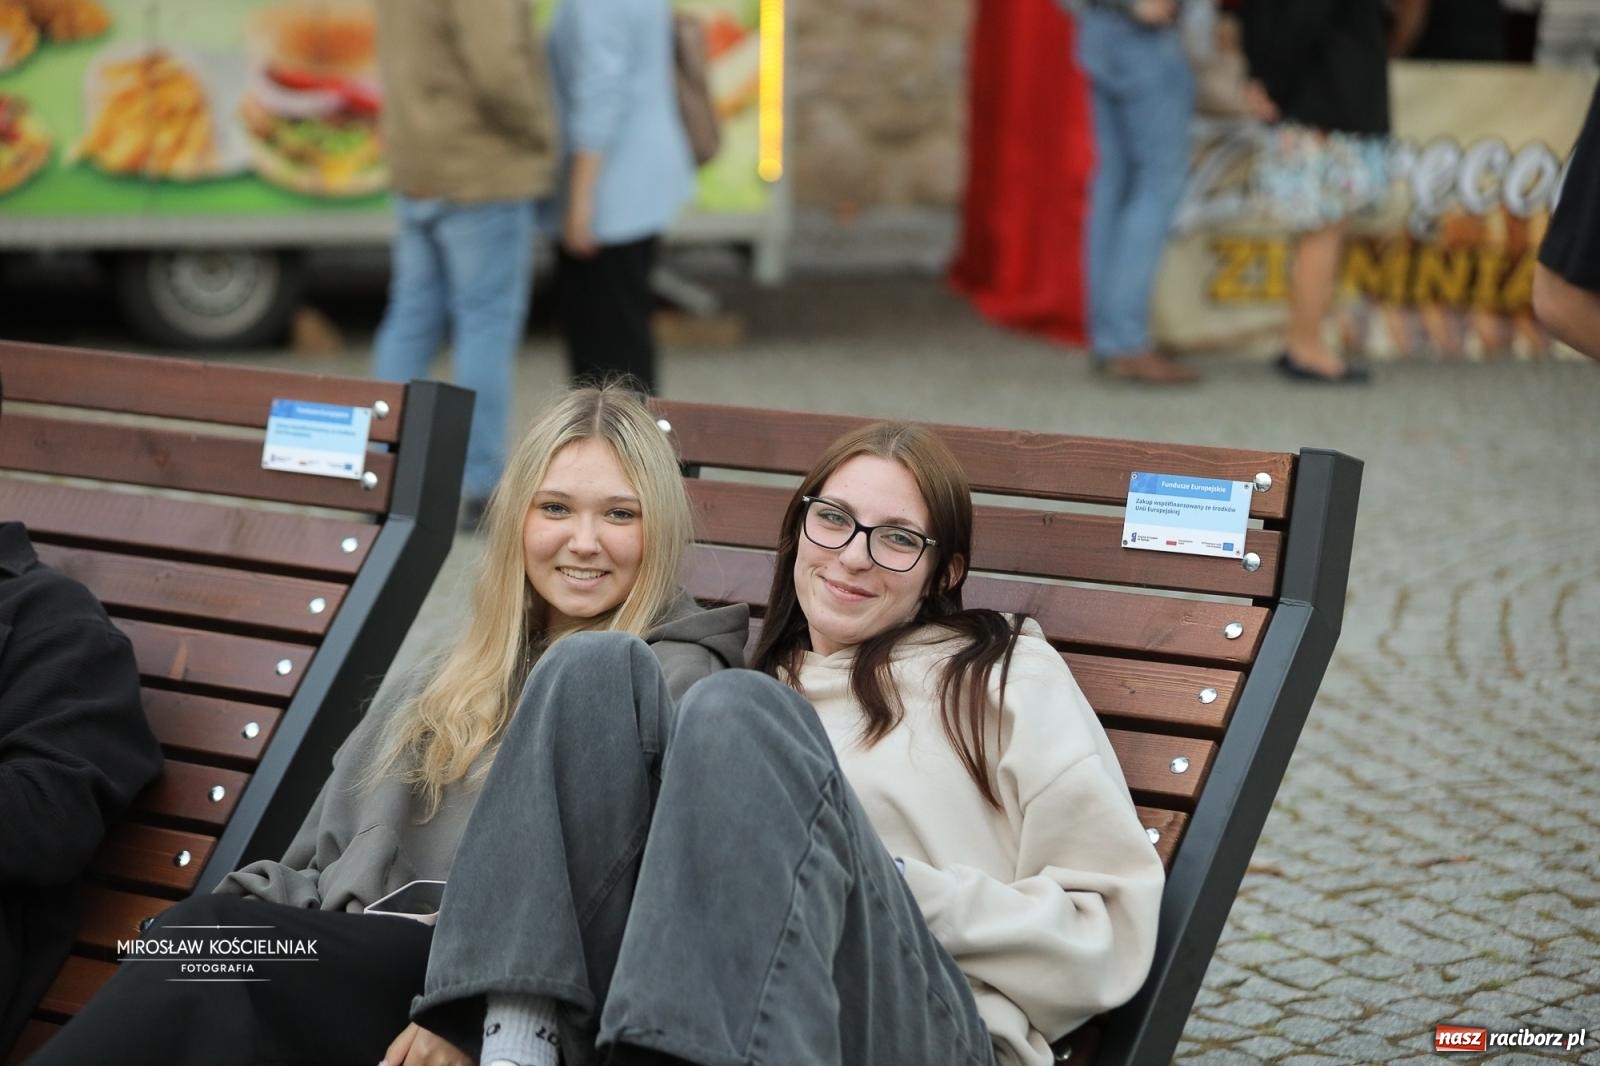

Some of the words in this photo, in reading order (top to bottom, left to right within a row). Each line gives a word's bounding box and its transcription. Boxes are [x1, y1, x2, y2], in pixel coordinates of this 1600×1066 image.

[1161, 480, 1190, 490] Fundusze
[1190, 483, 1226, 494] Europejskie
[1135, 498, 1153, 506] Zakup
